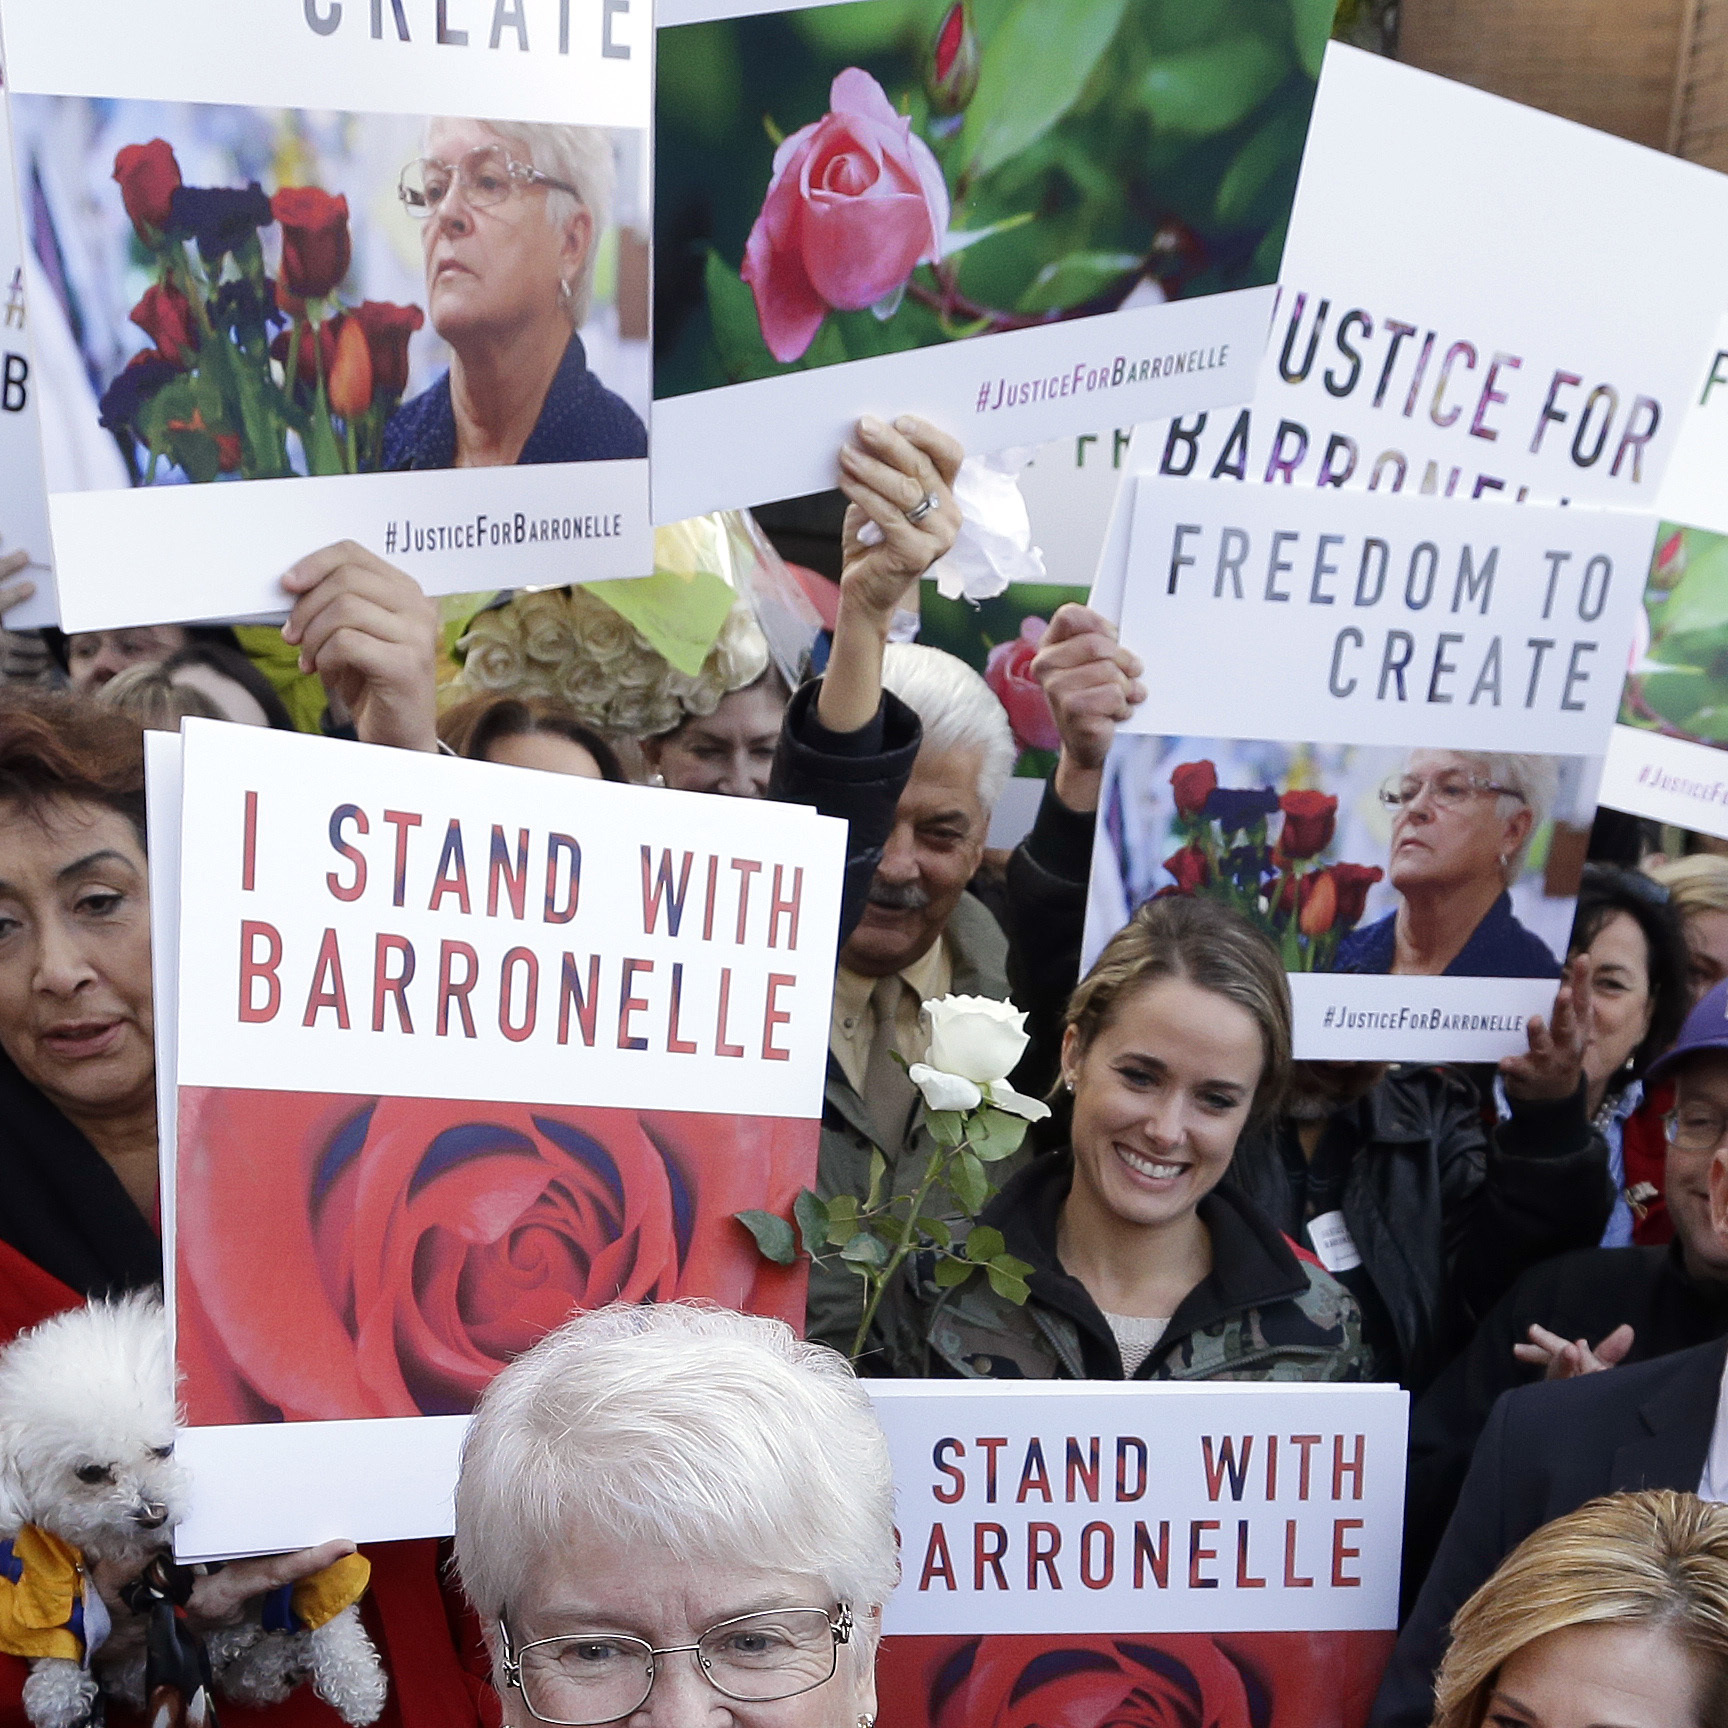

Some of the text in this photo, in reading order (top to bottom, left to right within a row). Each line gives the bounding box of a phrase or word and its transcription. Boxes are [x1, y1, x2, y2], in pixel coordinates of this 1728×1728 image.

[1528, 368, 1662, 484] FOR
[1167, 523, 1615, 622] FREEDOM TO
[1328, 625, 1599, 712] CREATE
[241, 790, 805, 951] I STAND WITH
[235, 918, 799, 1062] BARRONELLE
[932, 1433, 1366, 1505] STAND WITH
[891, 1517, 1365, 1592] ARRONELLE
